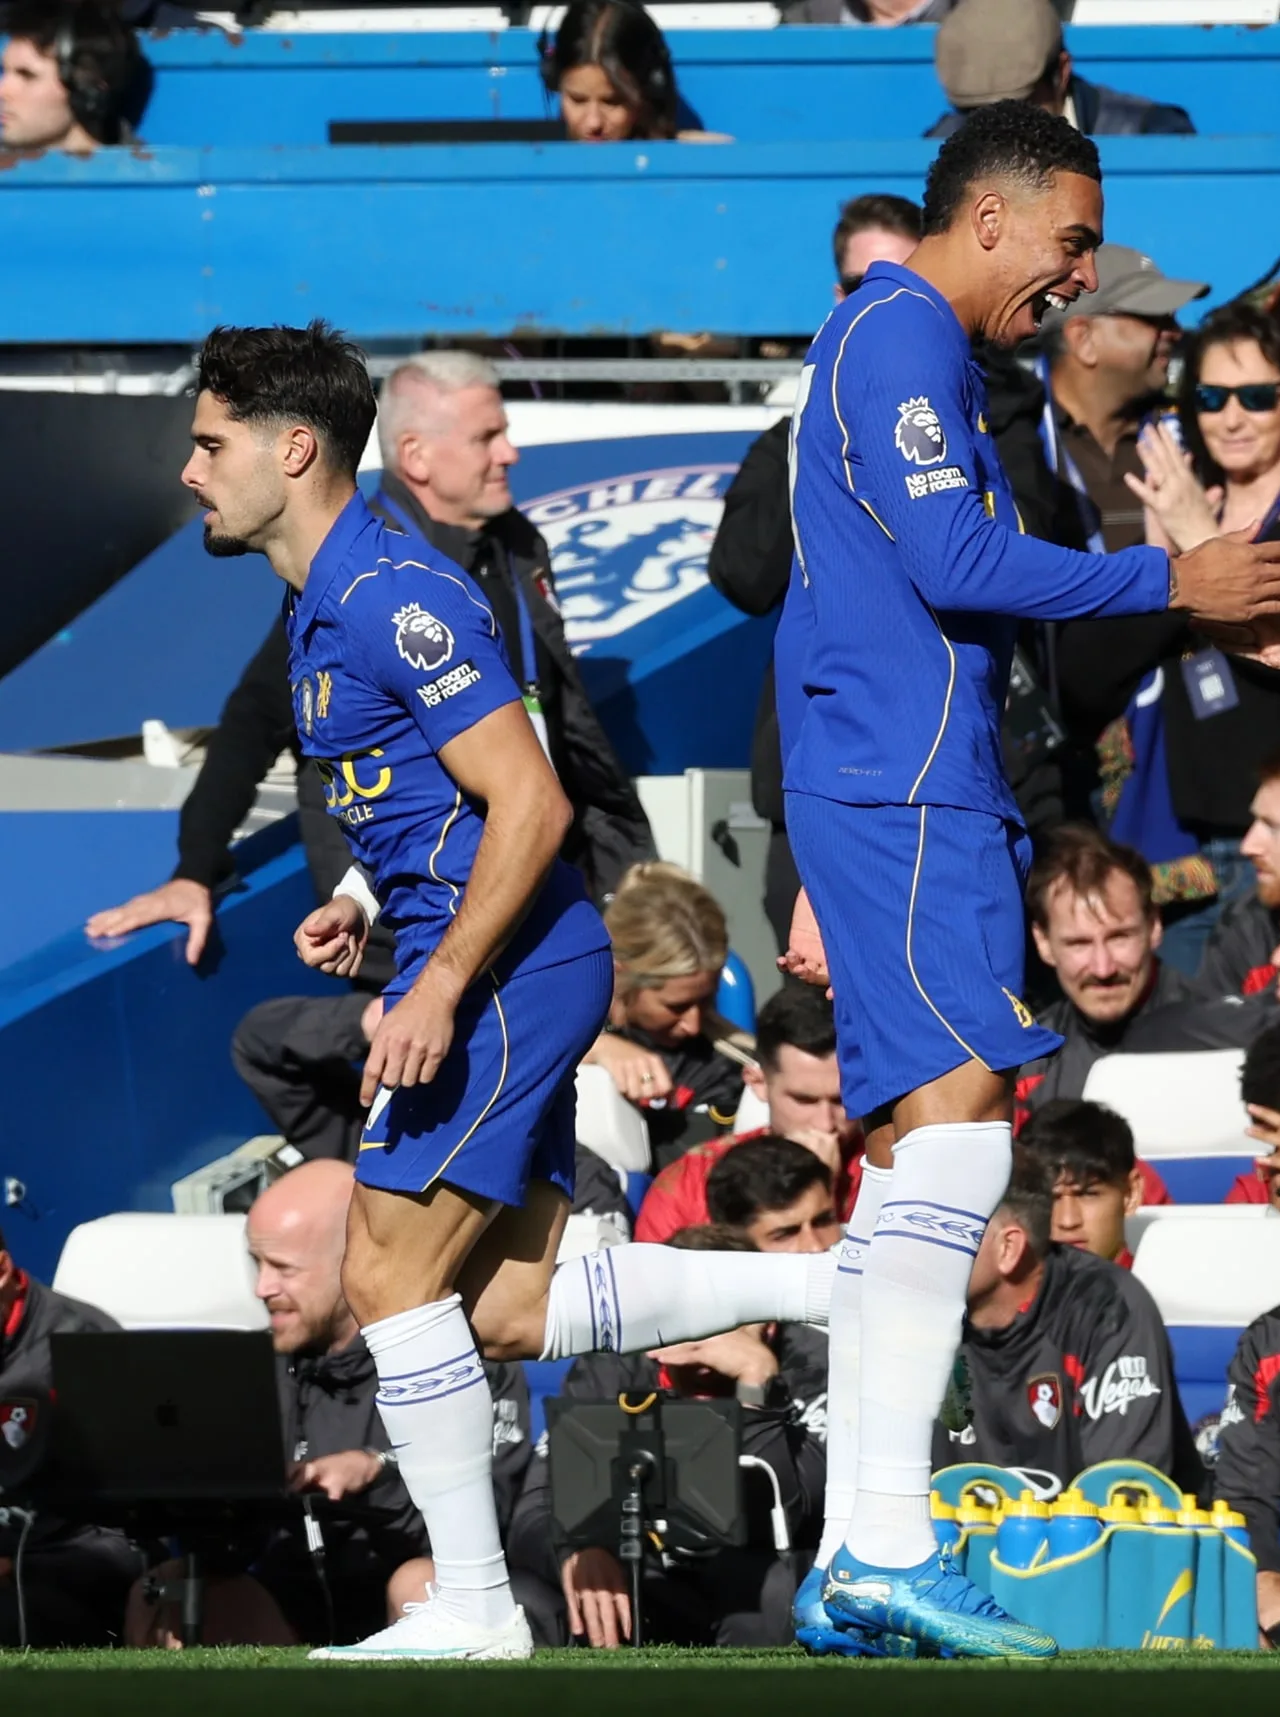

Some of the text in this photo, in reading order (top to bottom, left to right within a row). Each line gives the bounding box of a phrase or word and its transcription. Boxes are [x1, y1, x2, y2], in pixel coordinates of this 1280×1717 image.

[905, 467, 962, 490] No room
[909, 476, 969, 499] for racism
[416, 663, 471, 698] No room
[424, 670, 481, 708] for racism
[1080, 1361, 1161, 1420] Vegas
